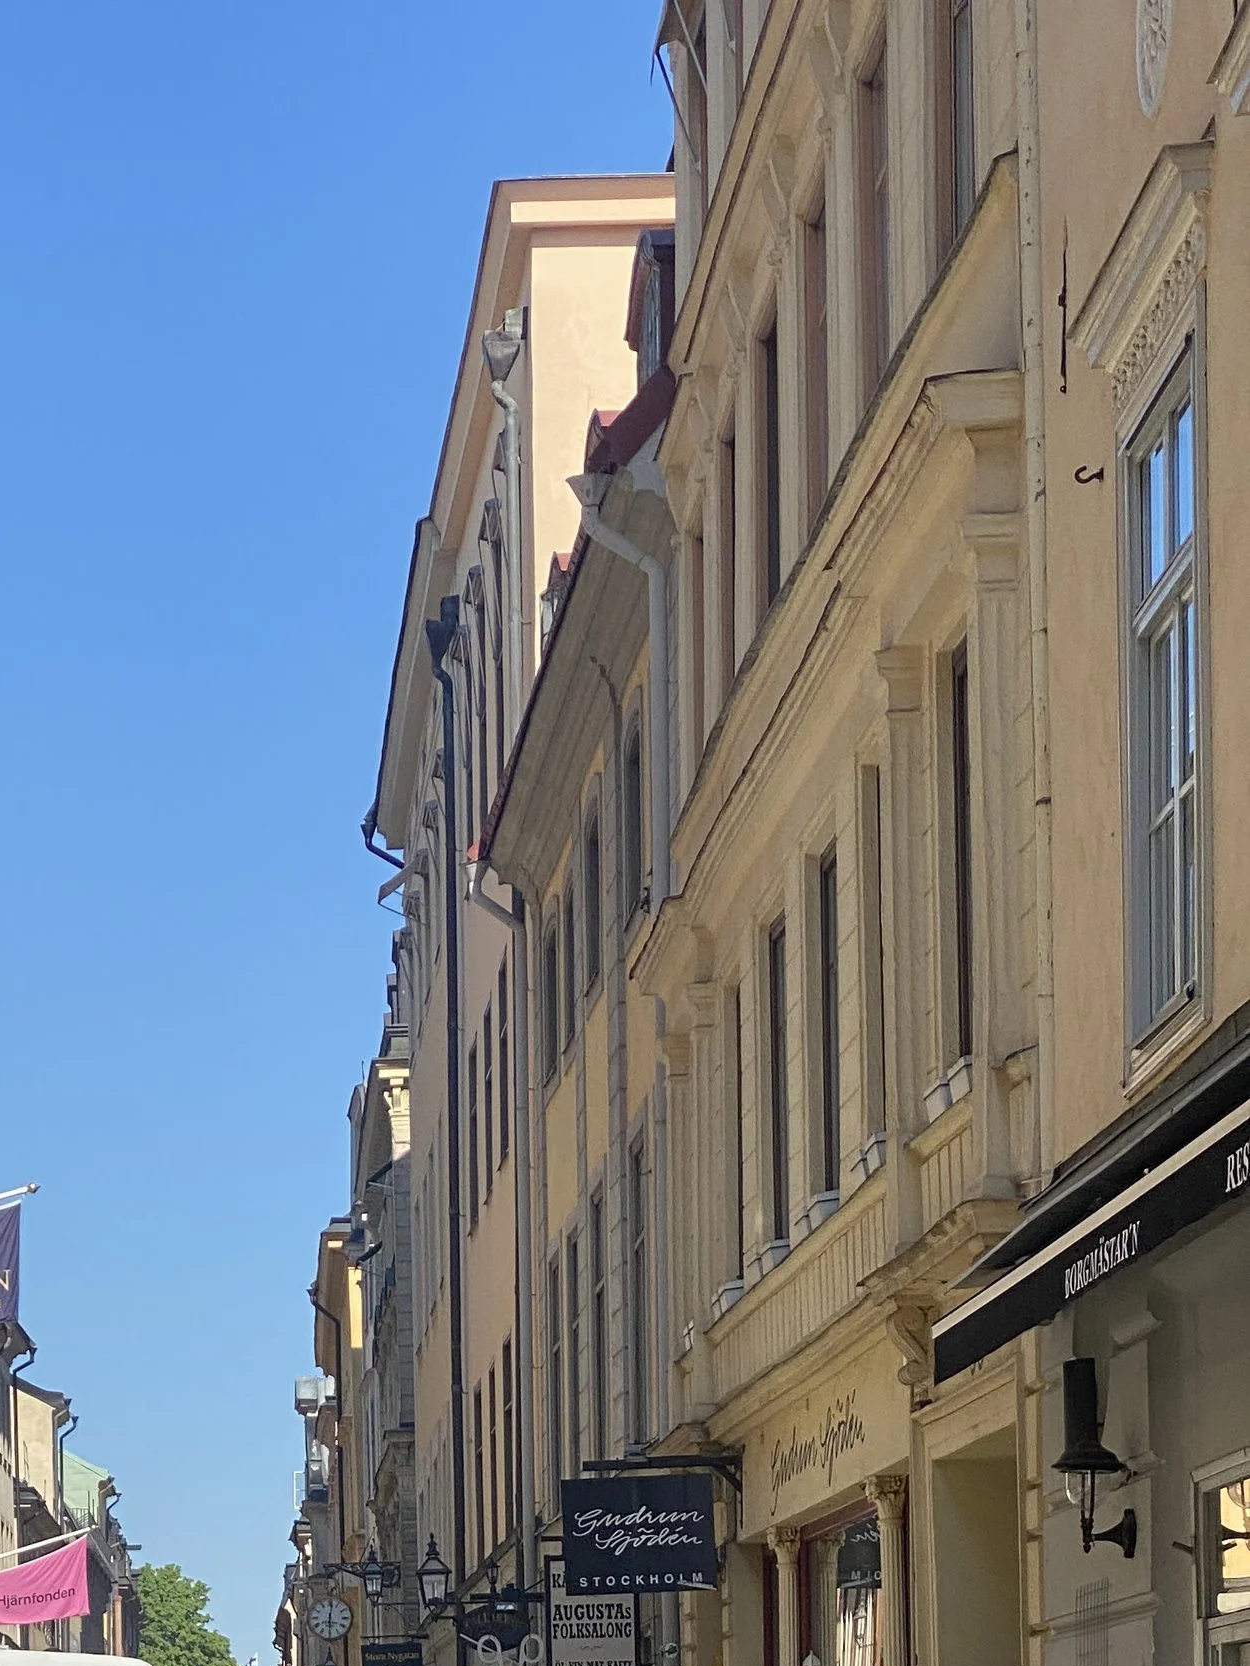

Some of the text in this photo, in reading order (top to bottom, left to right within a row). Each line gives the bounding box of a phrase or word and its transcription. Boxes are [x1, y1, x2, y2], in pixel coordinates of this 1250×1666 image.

[572, 1506, 705, 1536] Gudrun
[579, 1572, 704, 1587] STOCKHOLM
[553, 1622, 632, 1639] FOLKSALONG
